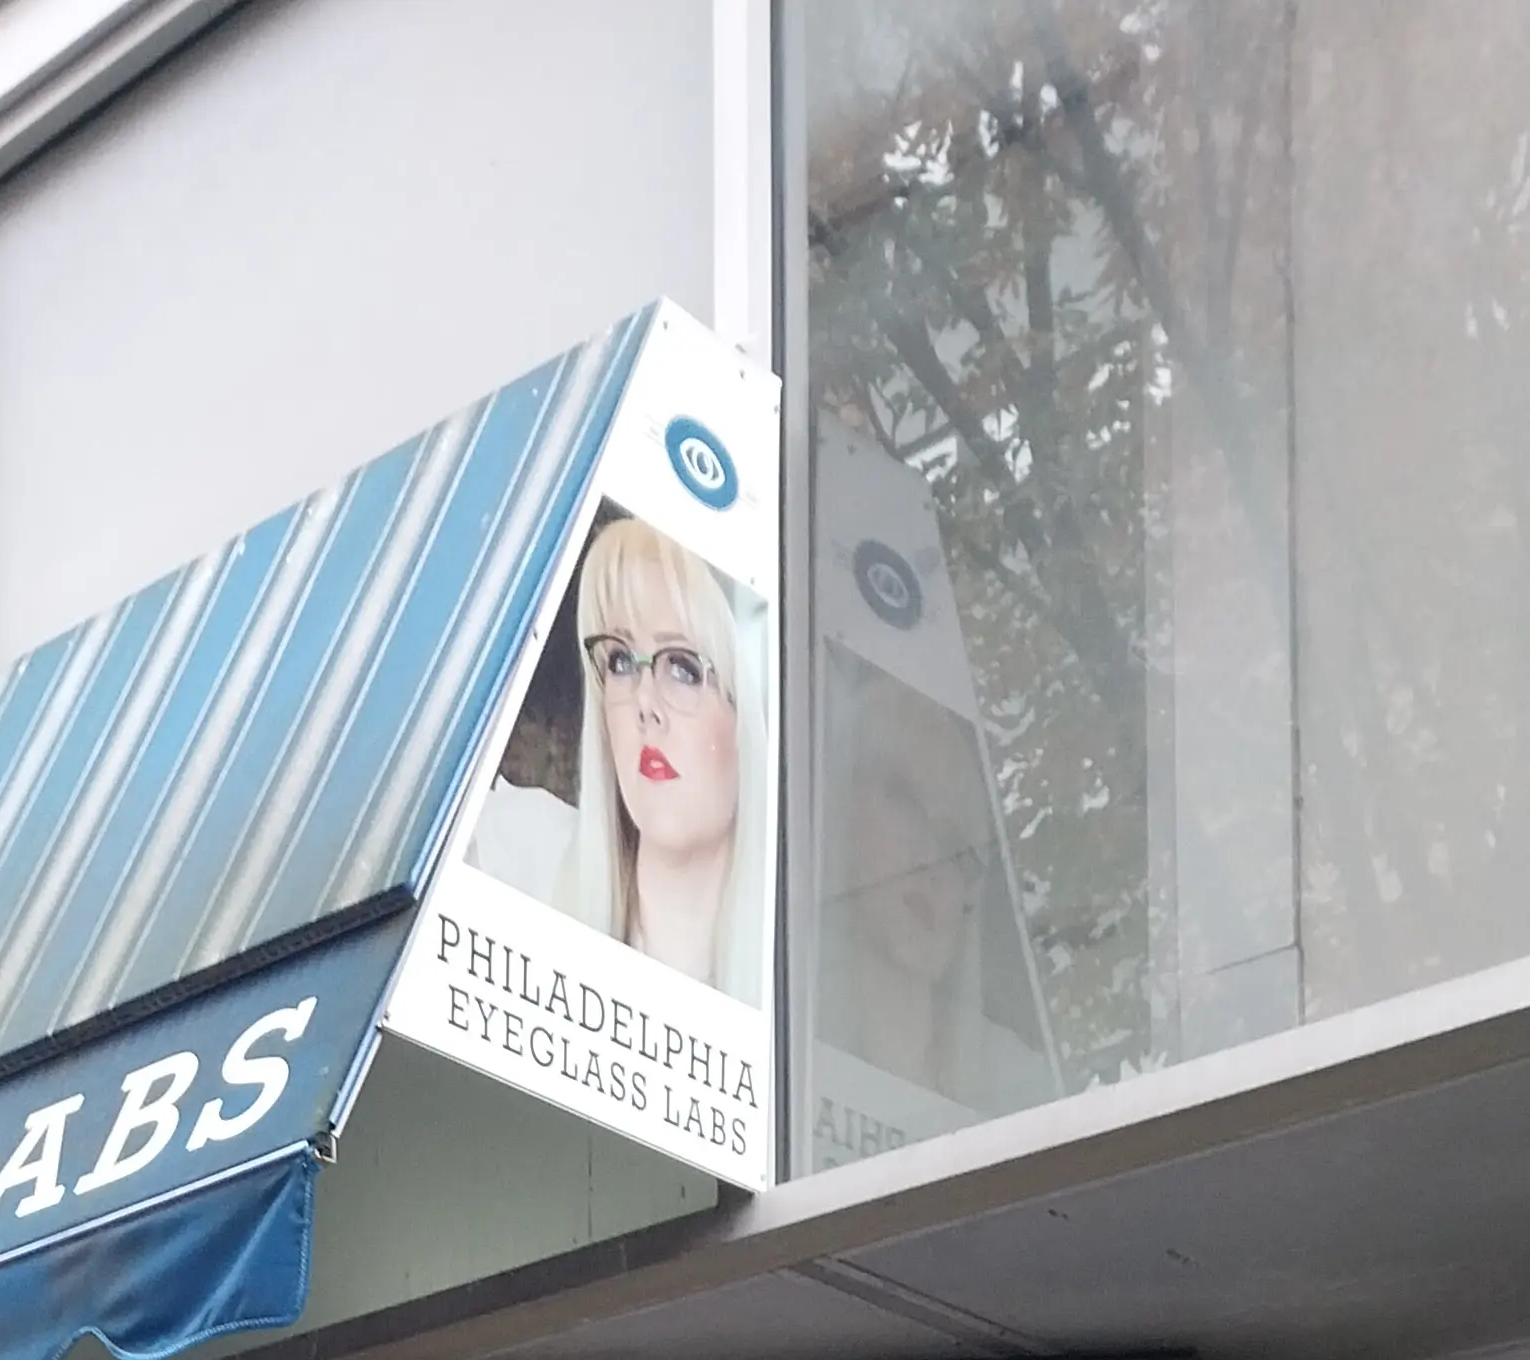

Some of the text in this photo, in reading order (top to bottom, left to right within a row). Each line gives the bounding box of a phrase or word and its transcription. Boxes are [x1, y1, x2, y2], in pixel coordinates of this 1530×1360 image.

[436, 913, 759, 1110] PHILADELPHIA
[448, 984, 747, 1156] EYEGLASS LABS
